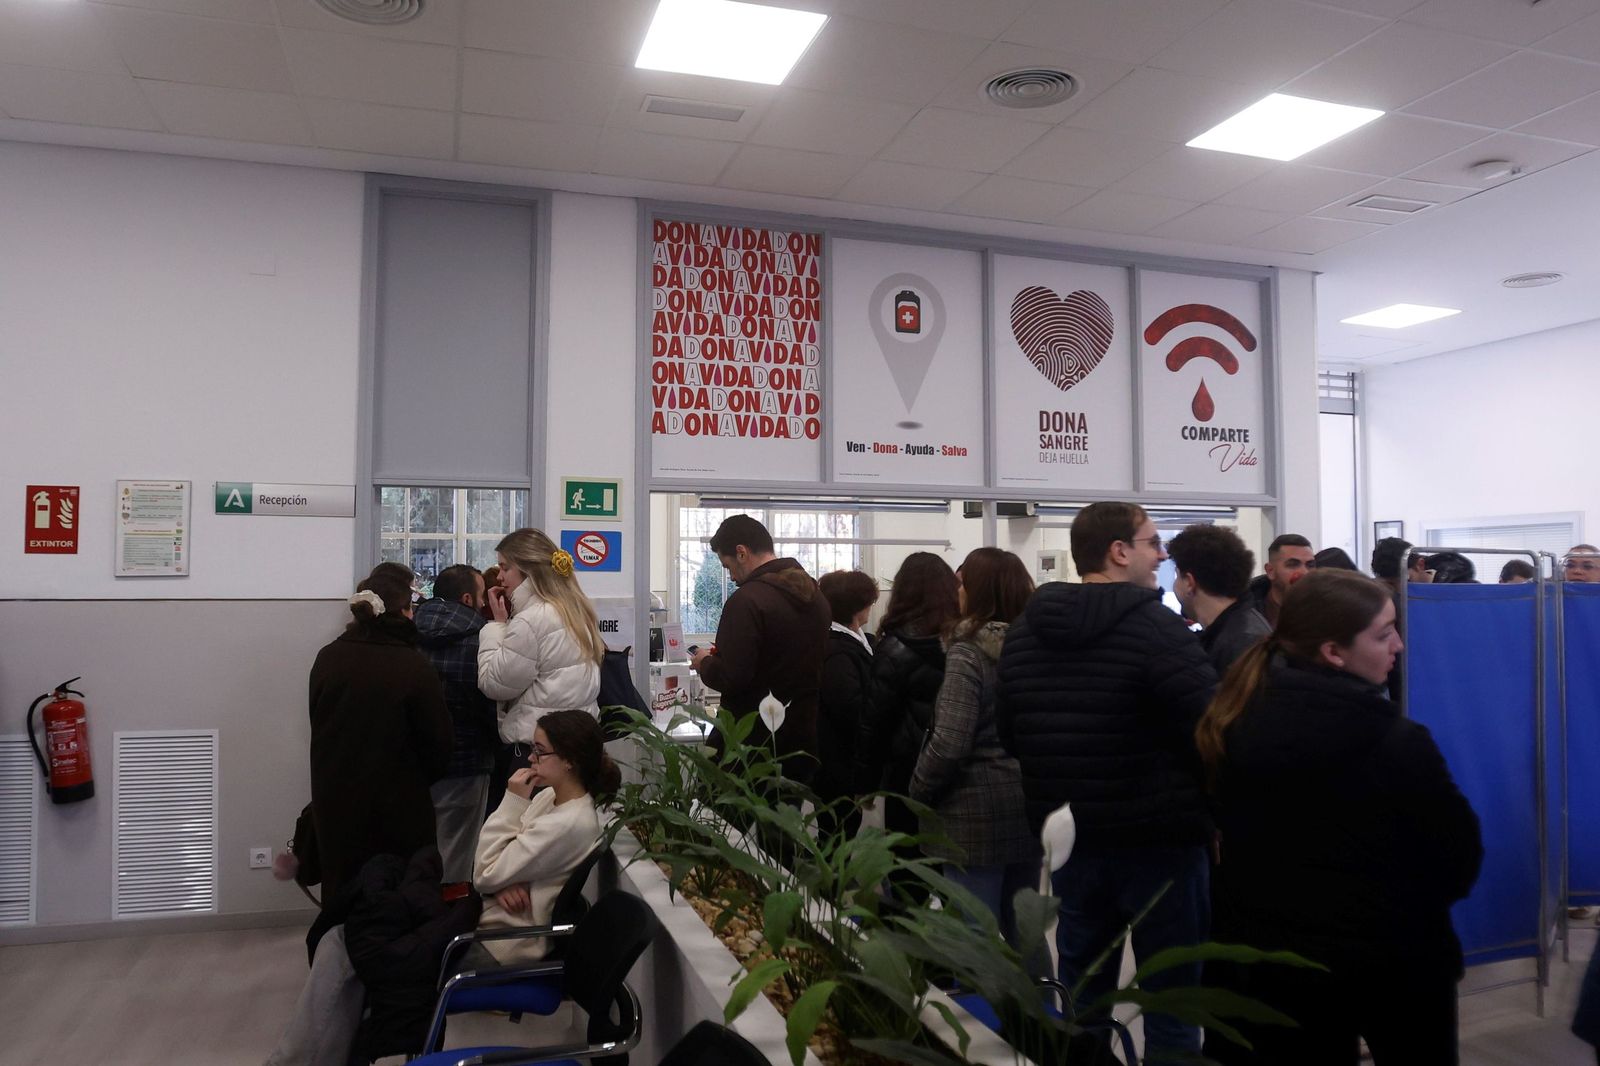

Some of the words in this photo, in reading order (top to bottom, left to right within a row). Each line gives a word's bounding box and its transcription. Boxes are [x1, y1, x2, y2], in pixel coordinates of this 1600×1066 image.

[1039, 410, 1088, 434] DONA
[1181, 425, 1250, 443] COMPARTE
[846, 441, 866, 453] Ven
[873, 442, 898, 454] Dona
[905, 443, 935, 456] Ayuda
[941, 445, 967, 457] Salva
[1039, 434, 1089, 451] SANGRE
[1039, 452, 1058, 464] DEJA
[1060, 453, 1089, 465] HUELLA
[1208, 443, 1258, 473] Vida
[259, 494, 308, 507] Recepción
[29, 540, 74, 548] EXTINTOR
